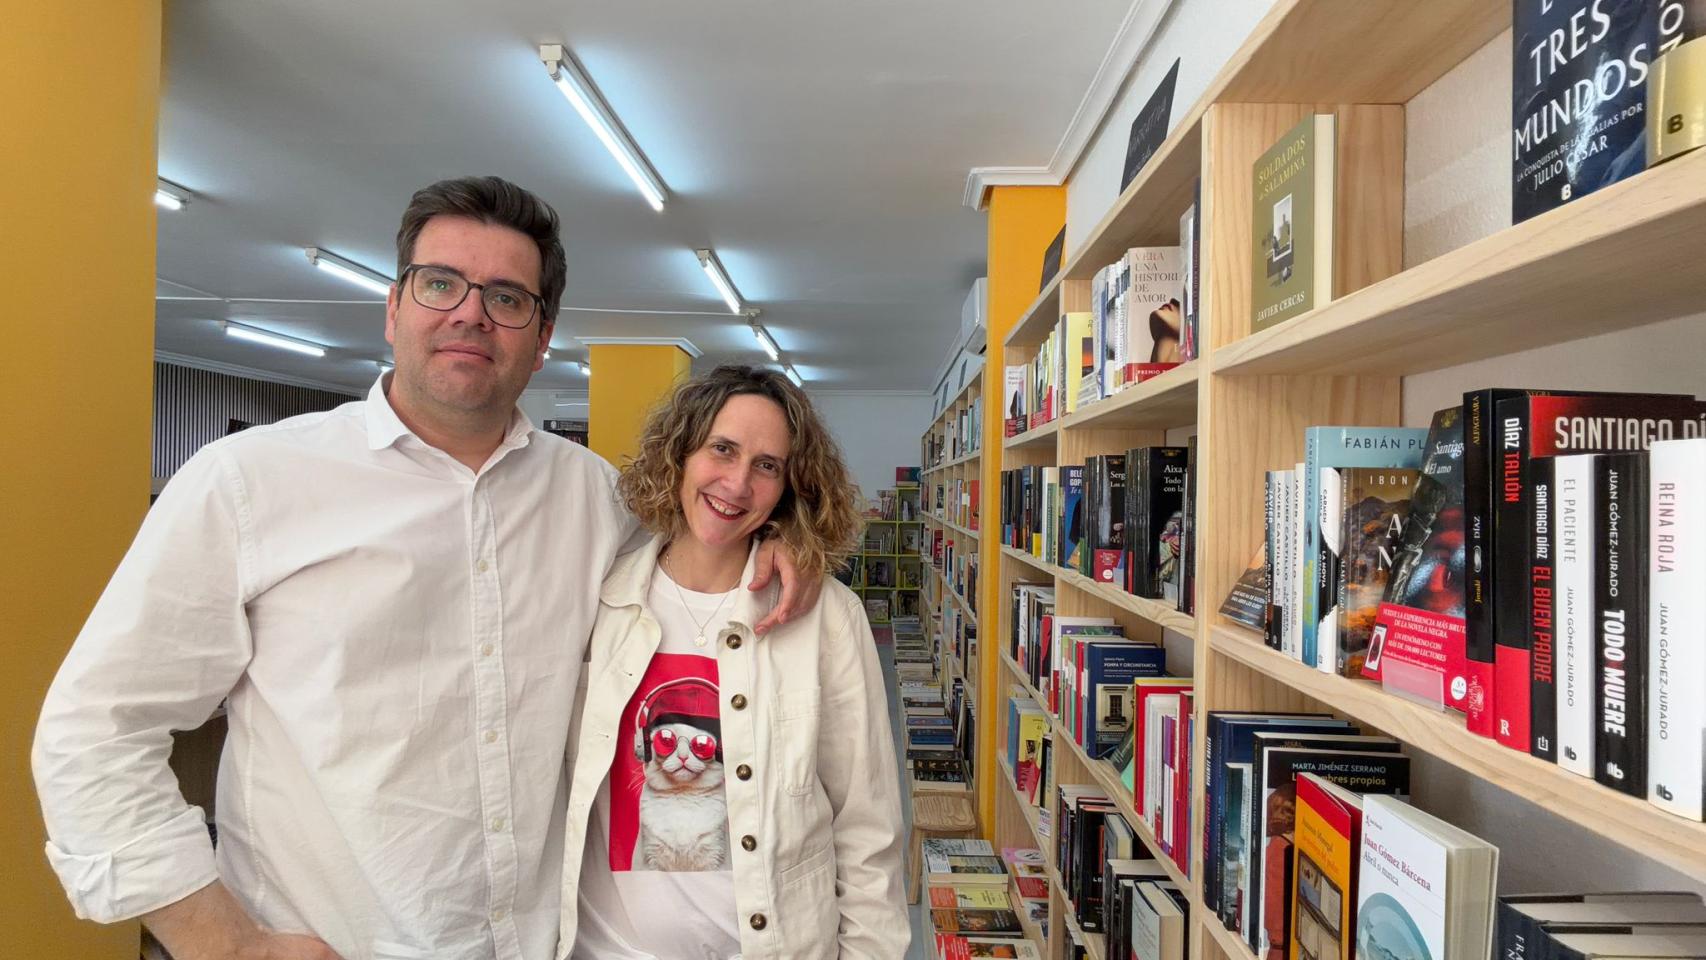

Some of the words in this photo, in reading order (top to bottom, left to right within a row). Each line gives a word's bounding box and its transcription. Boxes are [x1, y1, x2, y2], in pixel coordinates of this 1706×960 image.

[1530, 0, 1611, 86] TRES
[1514, 43, 1649, 161] MUNDOS
[1667, 114, 1684, 134] B
[1524, 149, 1559, 178] CONQUISTA
[1560, 142, 1570, 153] DE
[1621, 102, 1644, 120] POR
[1258, 133, 1306, 185] SOLDADOS
[1265, 154, 1305, 193] SALAMINA
[1534, 159, 1564, 190] JULIO
[1561, 184, 1572, 200] B
[1135, 252, 1165, 261] VERA
[1135, 262, 1158, 271] UNA
[1134, 284, 1150, 293] DE
[1135, 272, 1182, 282] HISTORI
[1134, 294, 1168, 303] AMOR
[1257, 303, 1279, 322] JAVIER
[1279, 291, 1305, 311] CERCAS
[1472, 395, 1480, 445] ALFAGUARA
[1504, 418, 1522, 449] DÍAZ
[1555, 416, 1674, 450] SANTIAGO
[1684, 413, 1706, 440] DÍ
[1345, 436, 1400, 449] FABIÁN
[1110, 471, 1126, 480] Serg
[1164, 465, 1182, 473] Aixa
[1369, 475, 1408, 486] IBON
[1504, 452, 1522, 502] TALIÓN
[1609, 469, 1618, 500] JUAN
[1563, 479, 1576, 493] EL
[1536, 485, 1548, 534] SANTIAGO
[1659, 483, 1675, 527] REINA
[1473, 516, 1481, 539] DÍAZ
[1563, 499, 1576, 563] PACIENTE
[1322, 550, 1327, 560] LA
[1536, 536, 1549, 559] DÍAZ
[1609, 503, 1620, 597] GÓMEZ-JURADO
[1657, 535, 1675, 573] ROJA
[1533, 566, 1552, 583] EL
[1533, 586, 1552, 628] BUEN
[1566, 587, 1574, 614] JUAN
[1449, 622, 1466, 634] BRUT
[1659, 602, 1668, 636] JUAN
[1603, 609, 1625, 661] TODO
[1533, 631, 1552, 684] PADRE
[1566, 617, 1576, 708] GÓMEZ-JURADO
[1603, 666, 1626, 738] MUERE
[1658, 638, 1671, 740] GÓMEZ-JURADO
[1500, 719, 1510, 736] R
[1317, 762, 1349, 771] JIMÉNEZ
[1325, 775, 1348, 784] mbres
[1350, 775, 1386, 787] propios
[1364, 833, 1378, 851] Juan
[1378, 844, 1400, 868] Gómez
[1401, 861, 1431, 892] Bárcena
